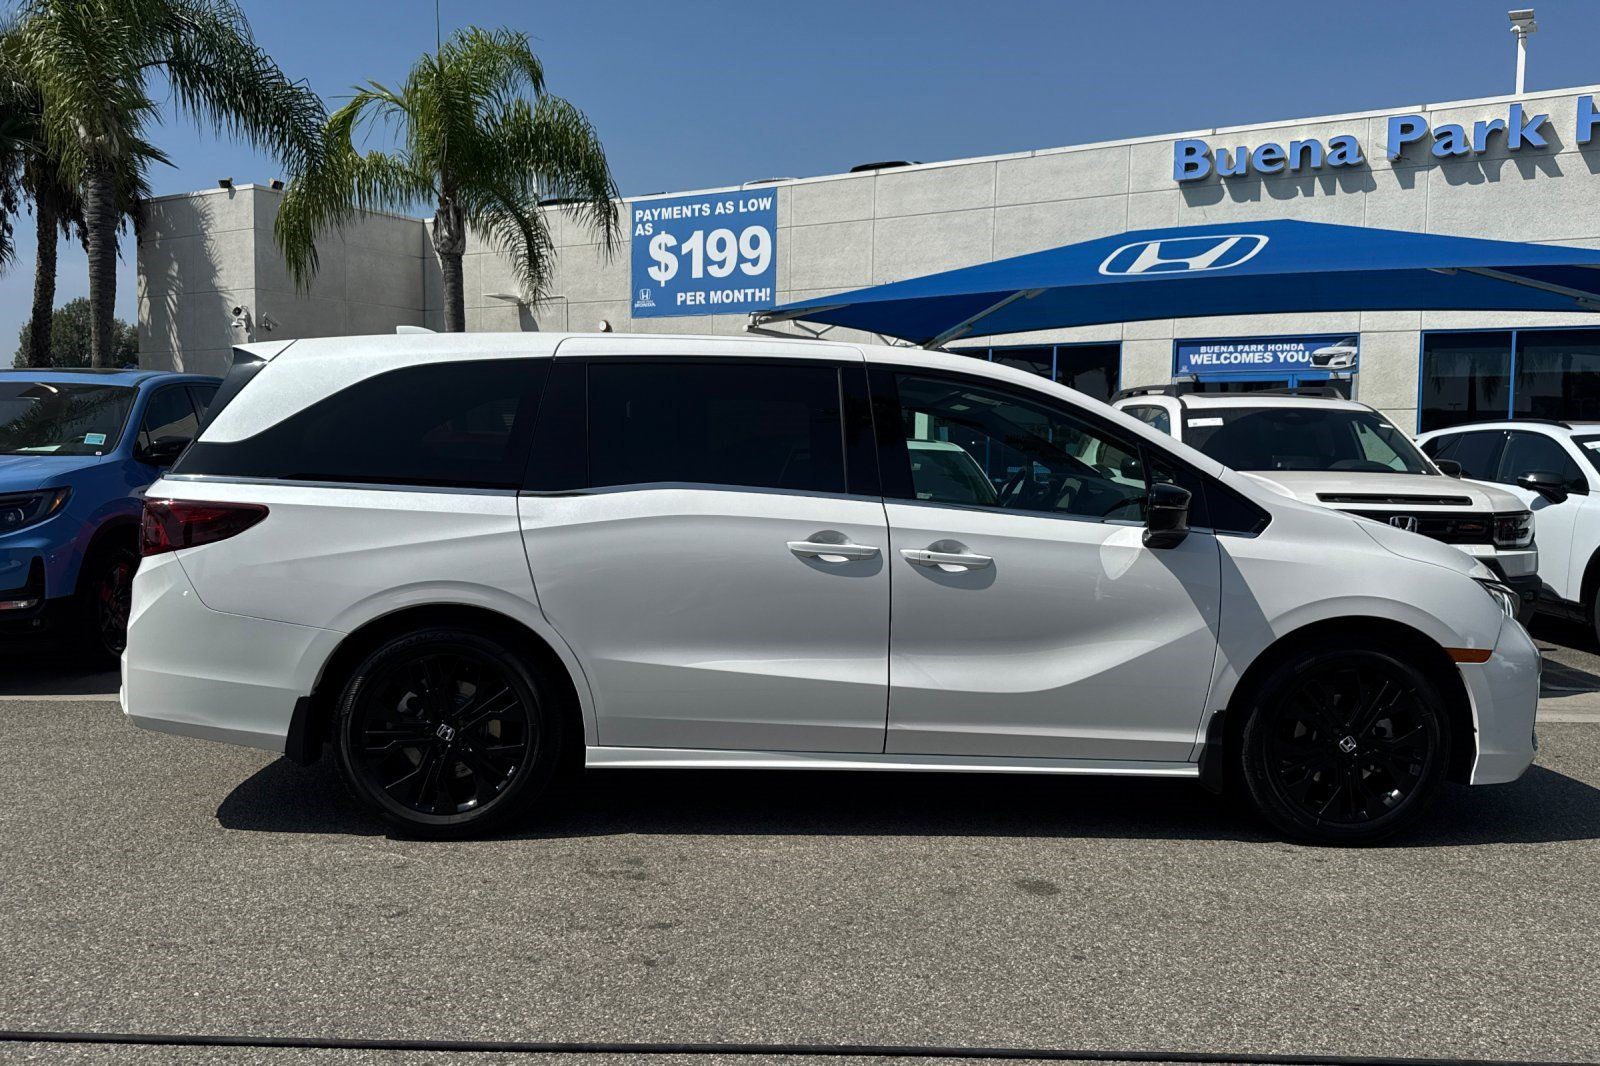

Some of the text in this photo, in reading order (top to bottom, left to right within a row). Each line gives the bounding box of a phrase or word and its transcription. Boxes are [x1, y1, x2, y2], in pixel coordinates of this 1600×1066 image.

[1173, 134, 1364, 183] Buena
[1387, 103, 1549, 163] Park
[635, 197, 772, 222] PAYMENTS AS LOW
[635, 223, 653, 236] AS
[647, 225, 772, 287] $199
[676, 288, 771, 305] PER MONTH!
[1200, 343, 1305, 353] BUENA PARK HONDA
[1189, 352, 1273, 365] WELCOMES
